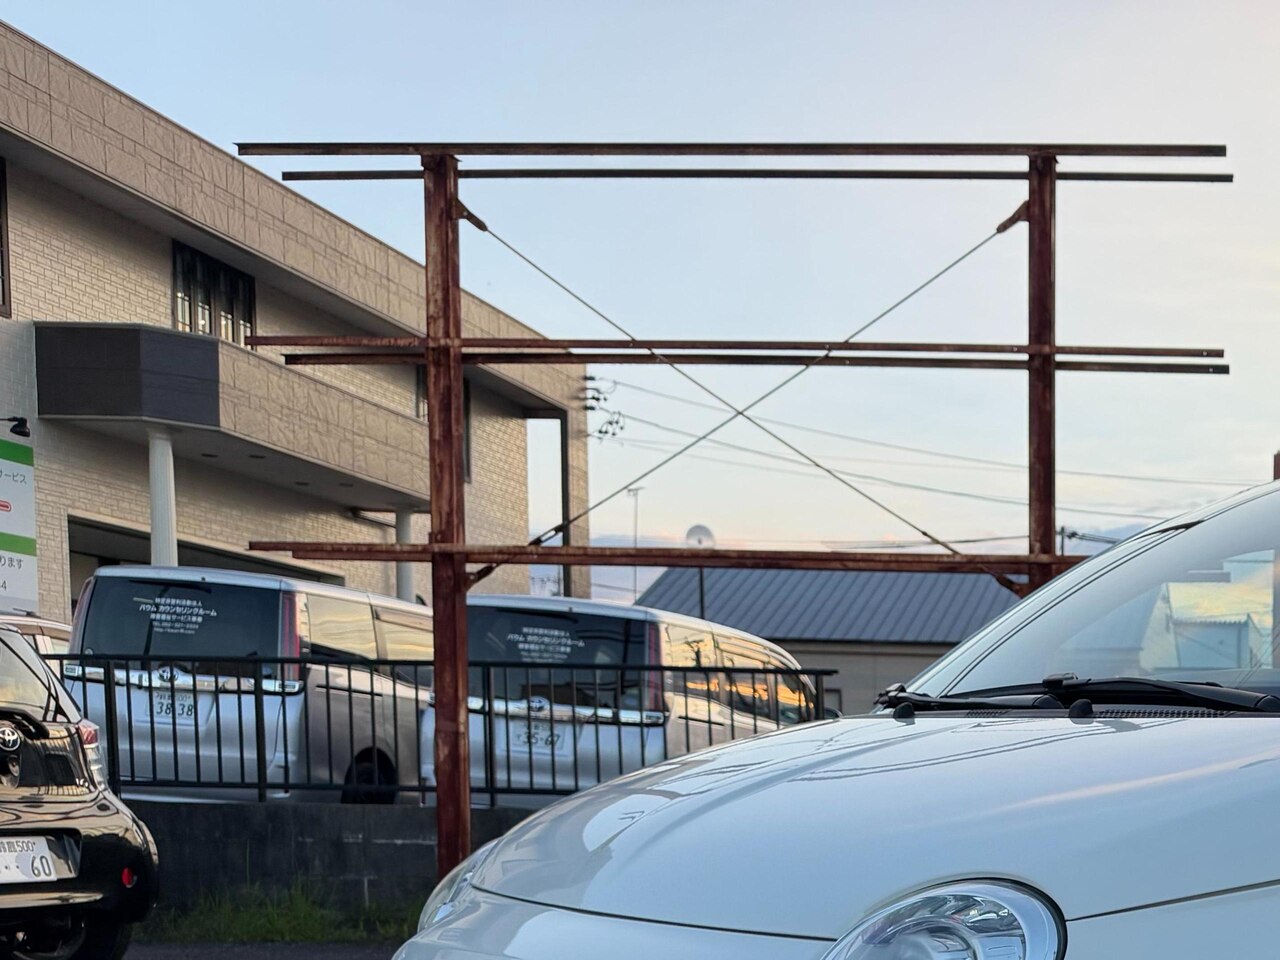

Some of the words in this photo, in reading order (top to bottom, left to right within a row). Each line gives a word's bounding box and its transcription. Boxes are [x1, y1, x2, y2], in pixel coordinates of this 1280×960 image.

[0, 469, 27, 485] ービス
[16, 840, 34, 853] 500
